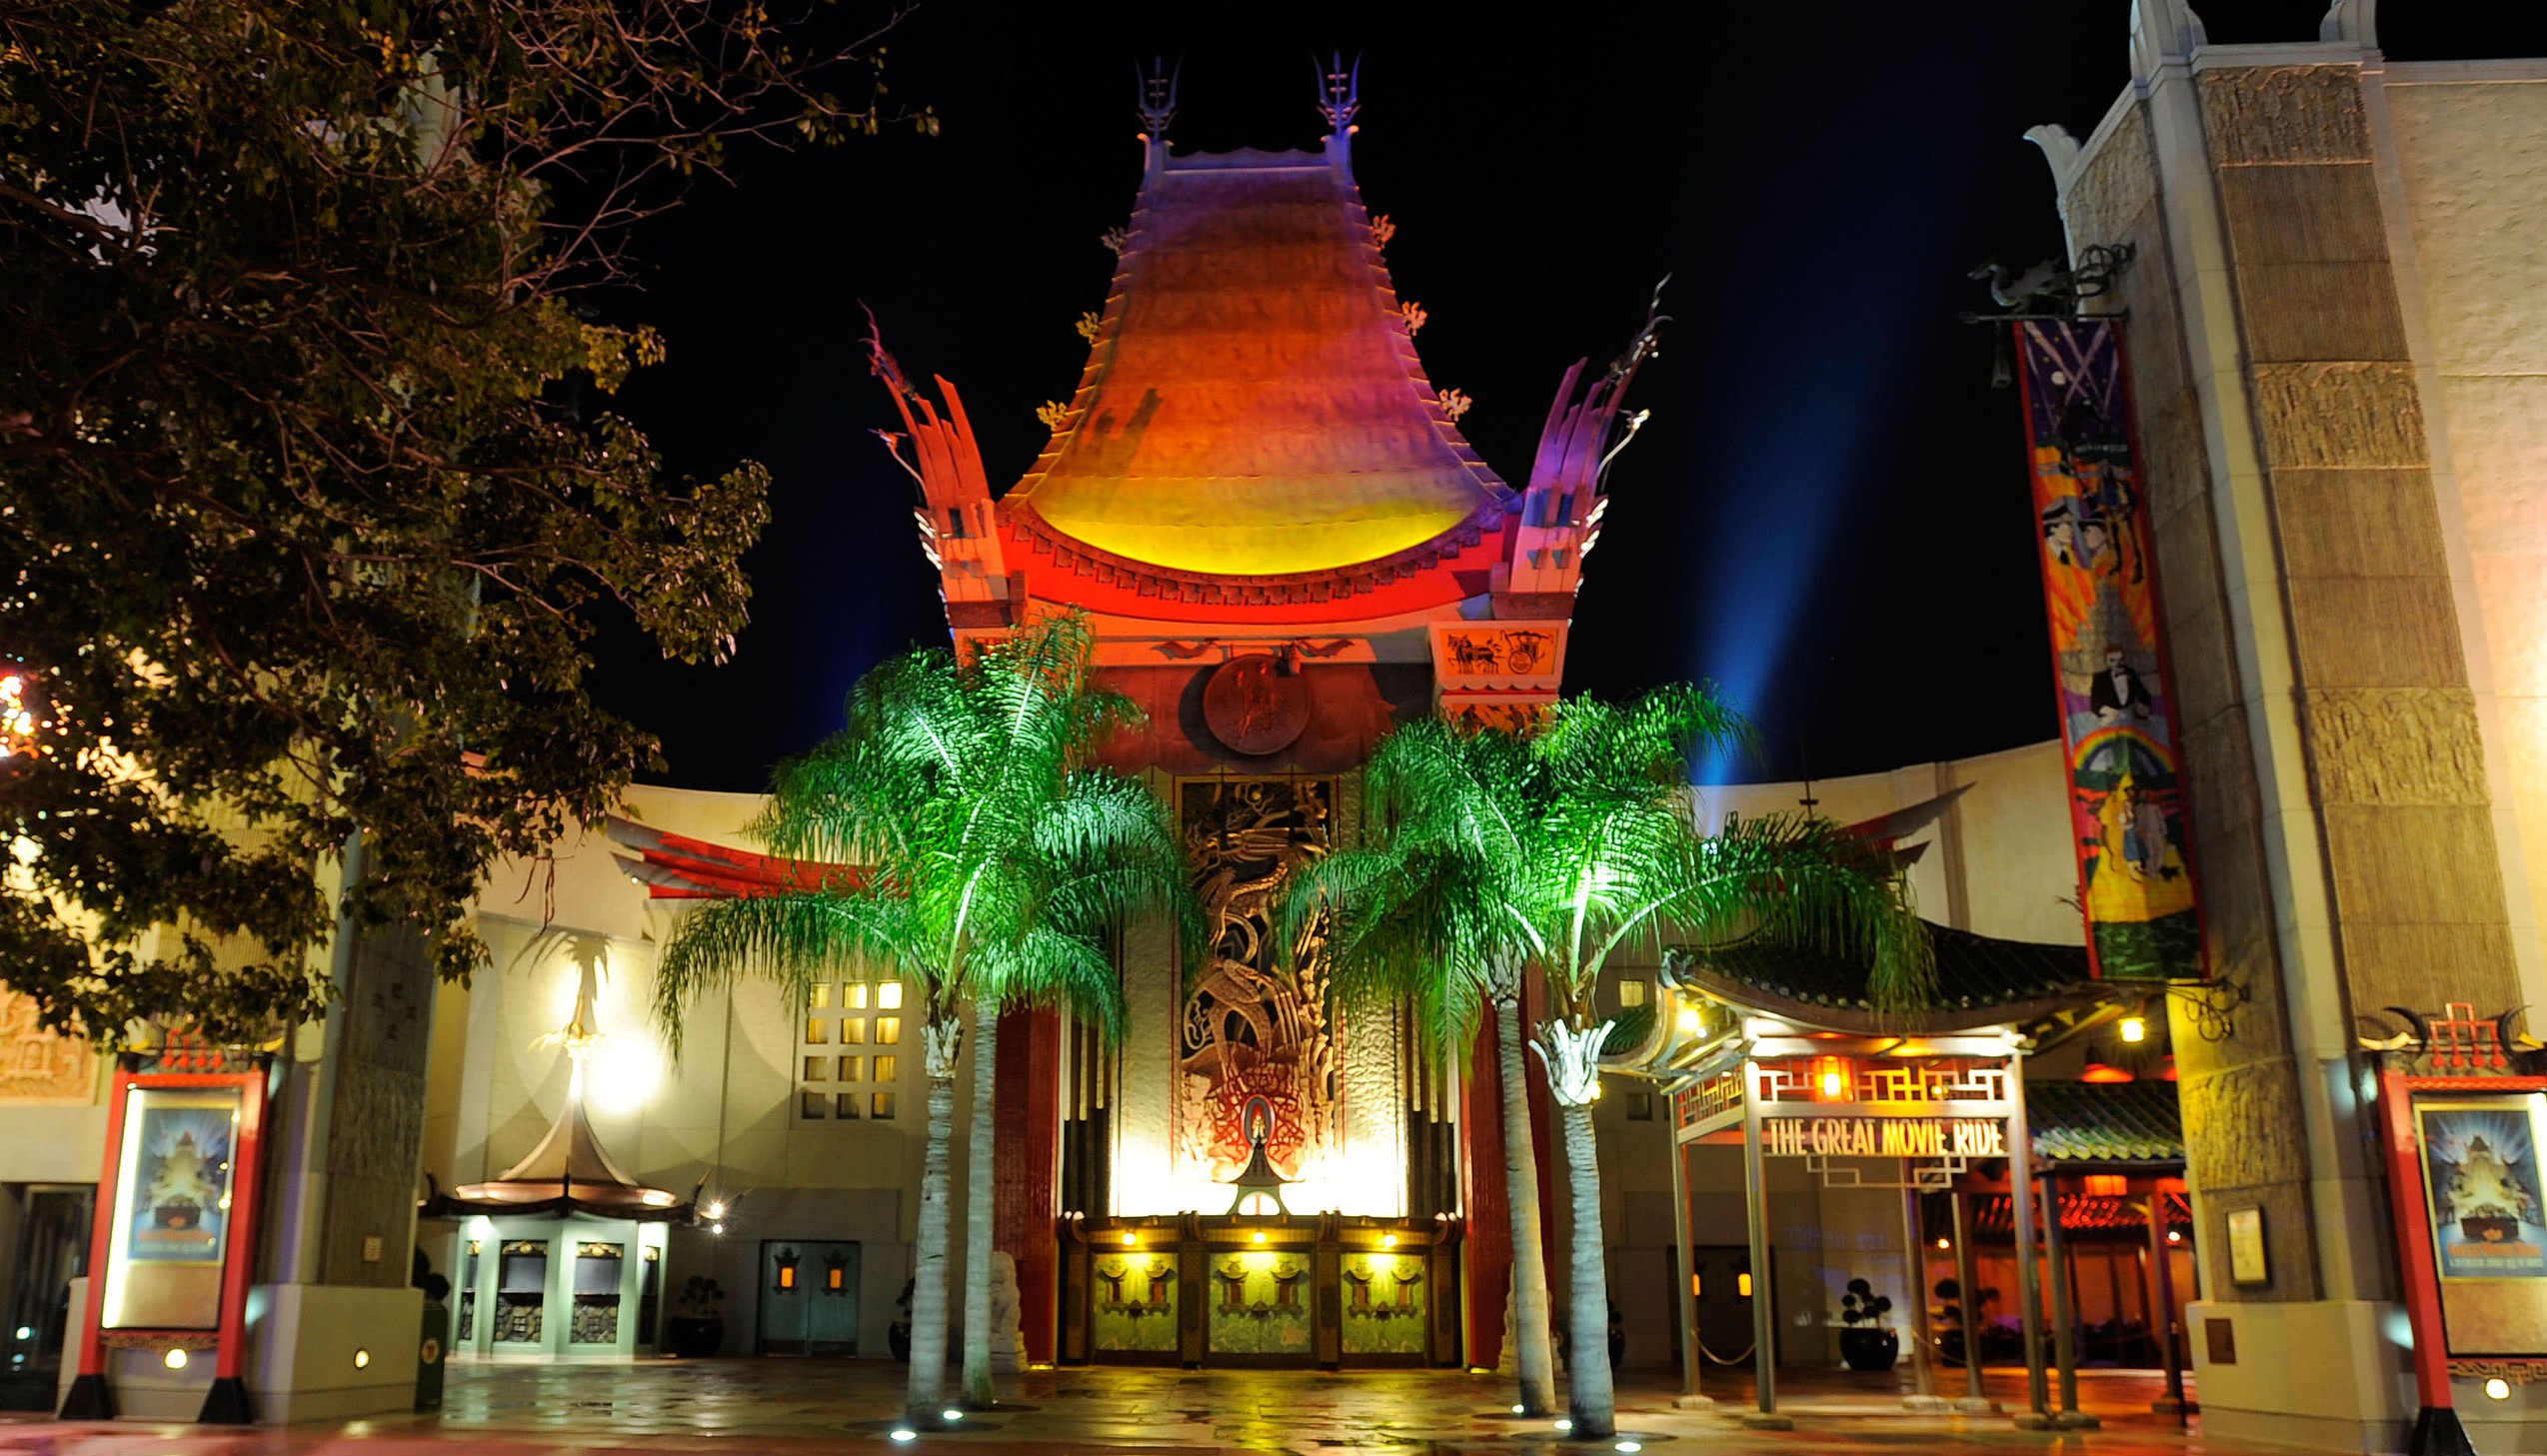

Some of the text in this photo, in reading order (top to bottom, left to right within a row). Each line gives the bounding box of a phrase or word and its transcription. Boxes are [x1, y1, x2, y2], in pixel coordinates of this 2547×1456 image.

[1768, 1118, 2004, 1155] THE GREAT MOVIE RIDE
